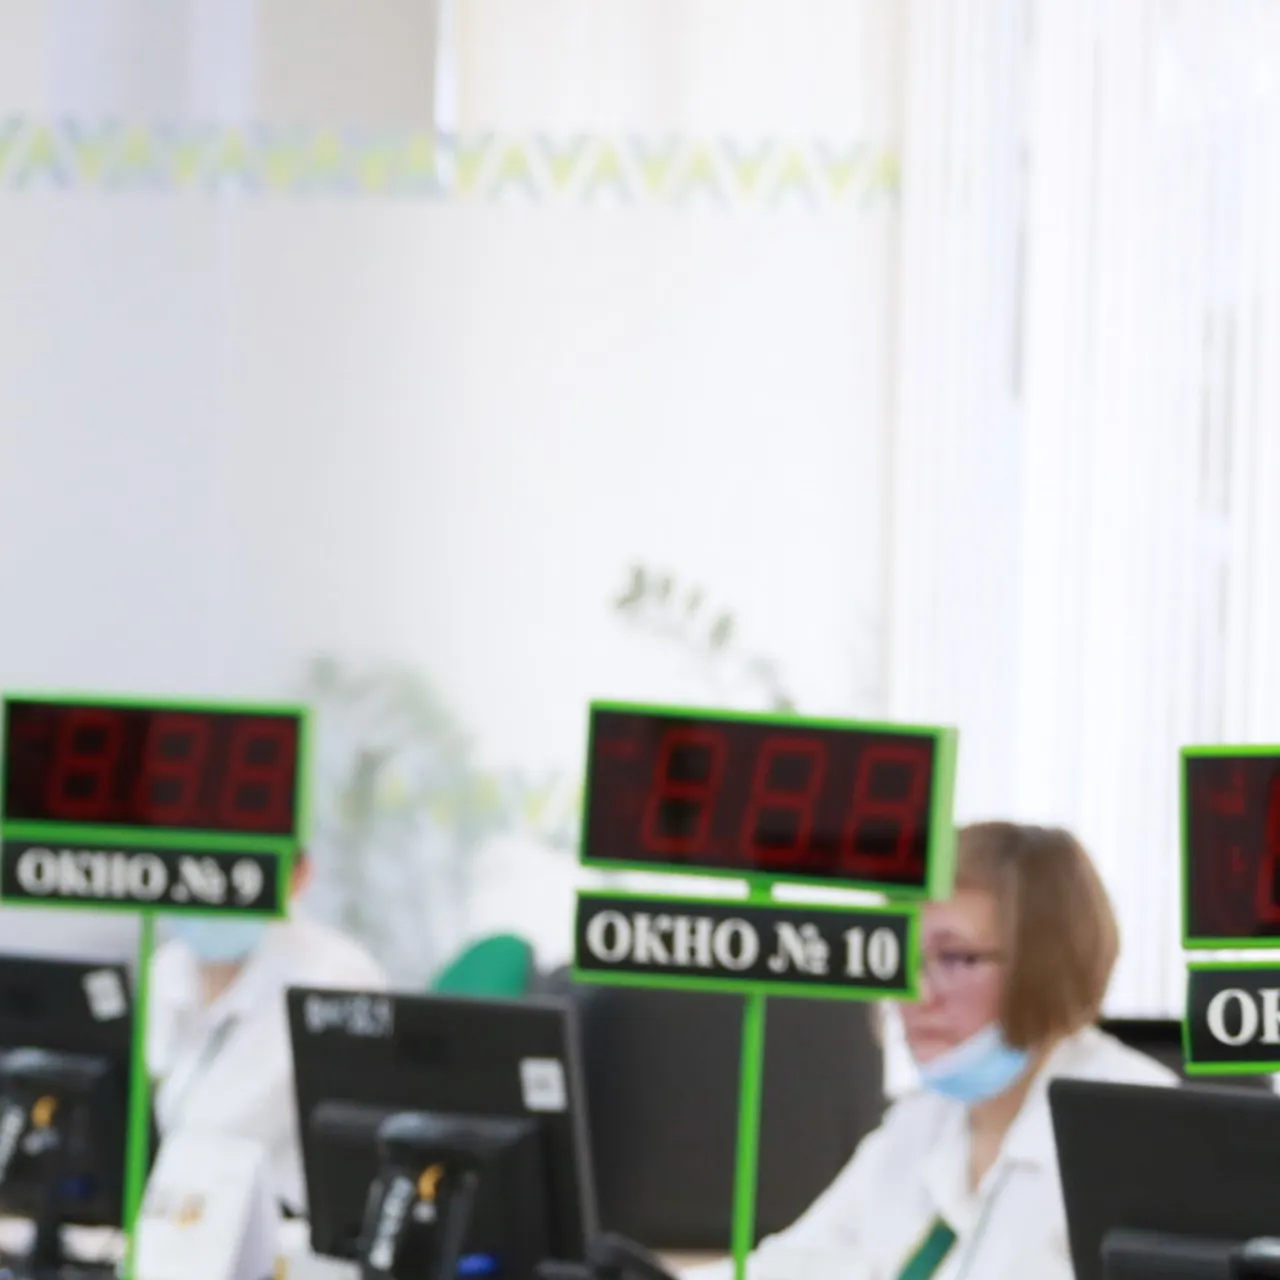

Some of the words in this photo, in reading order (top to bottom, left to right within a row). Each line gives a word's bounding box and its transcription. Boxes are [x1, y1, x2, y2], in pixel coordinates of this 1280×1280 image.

[17, 849, 167, 902] ОКНО
[171, 857, 226, 904] №
[232, 861, 264, 905] 9
[587, 911, 759, 969] ОКНО
[768, 922, 828, 974] №
[845, 927, 899, 979] 10
